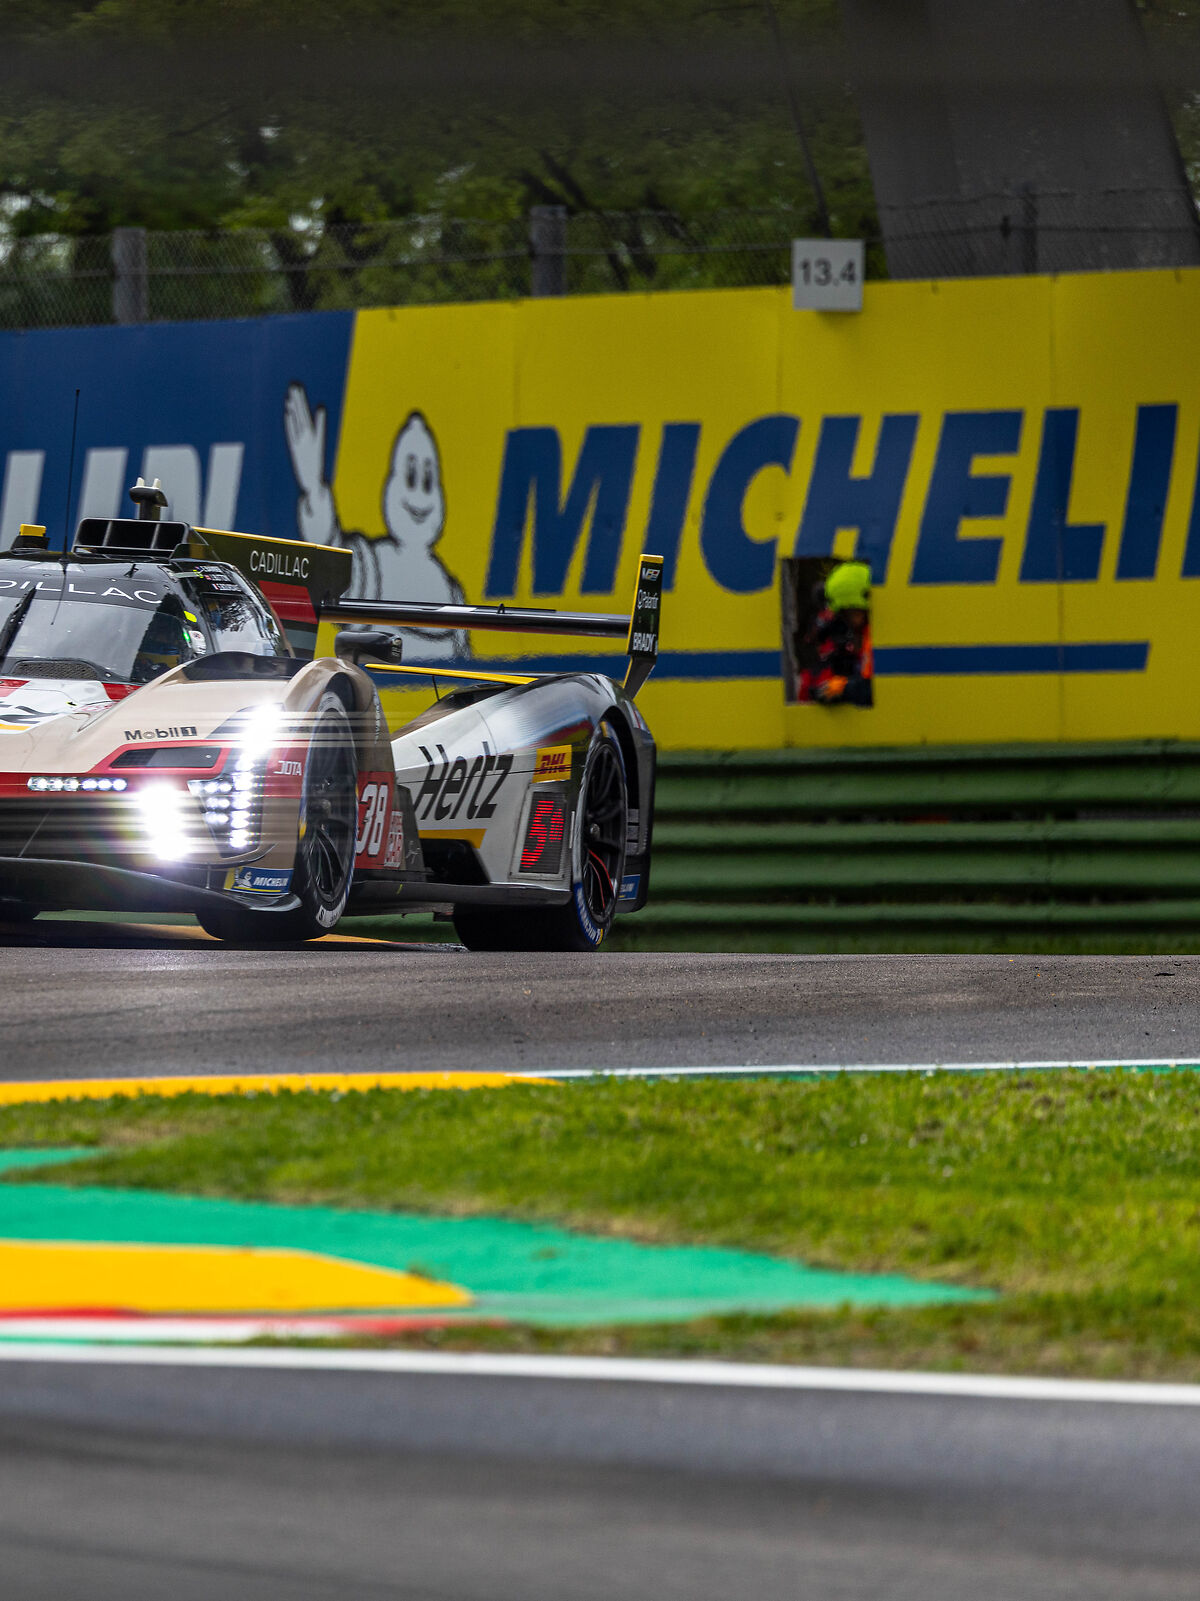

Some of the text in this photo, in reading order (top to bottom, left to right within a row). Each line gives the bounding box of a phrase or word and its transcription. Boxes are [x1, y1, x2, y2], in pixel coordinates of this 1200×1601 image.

[800, 261, 856, 286] 13.4
[485, 404, 1200, 597] MICHELI
[249, 550, 310, 579] CADILLAC
[273, 760, 302, 776] JOTA
[414, 741, 514, 821] Hertz
[356, 784, 389, 856] 38
[253, 876, 289, 887] MICHELIN
